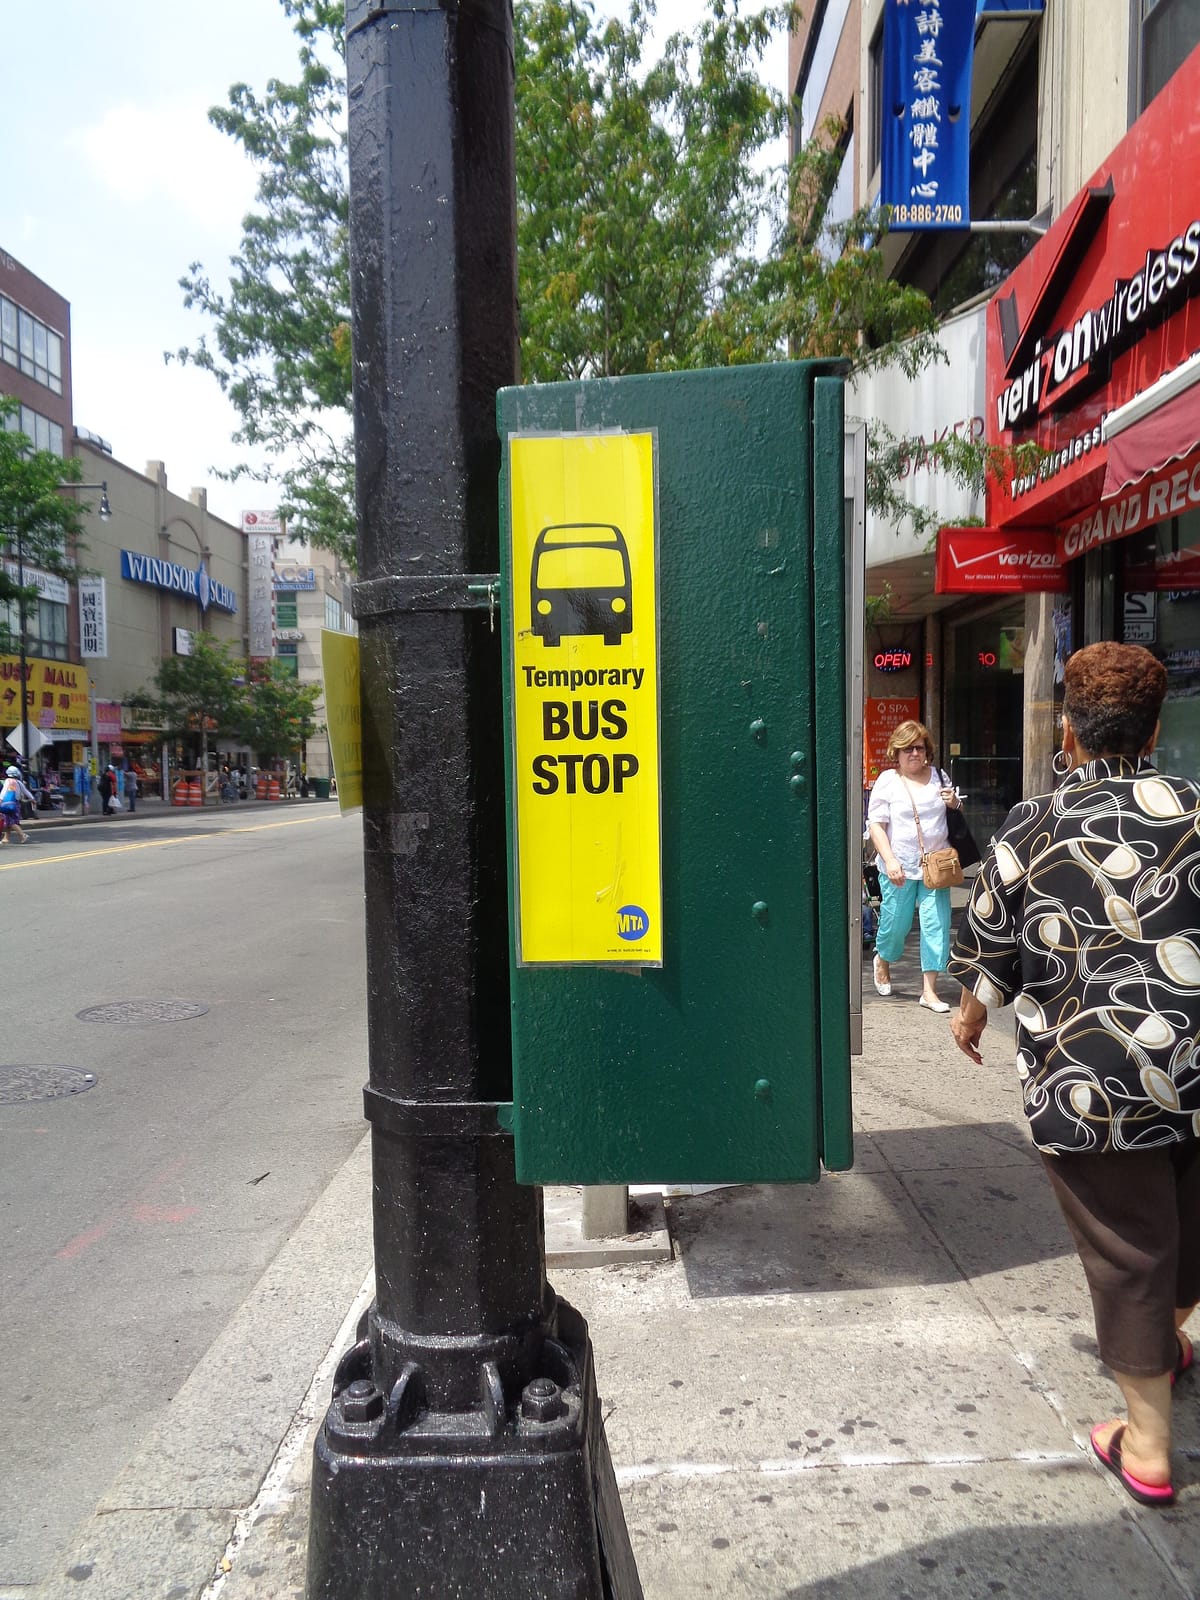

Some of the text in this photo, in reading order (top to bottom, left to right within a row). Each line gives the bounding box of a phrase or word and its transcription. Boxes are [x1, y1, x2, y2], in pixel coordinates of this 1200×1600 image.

[910, 0, 943, 198] 詩美容纖體中心
[997, 220, 1200, 432] verizon wireless
[1064, 494, 1142, 556] GRAND
[127, 552, 198, 596] WINDSOR
[0, 662, 78, 688] USY MALL
[521, 665, 645, 691] Temporary
[874, 652, 911, 667] OPEN
[542, 699, 628, 740] BUS
[889, 703, 909, 713] SPA
[532, 753, 639, 795] STOP
[617, 913, 643, 933] MTA
